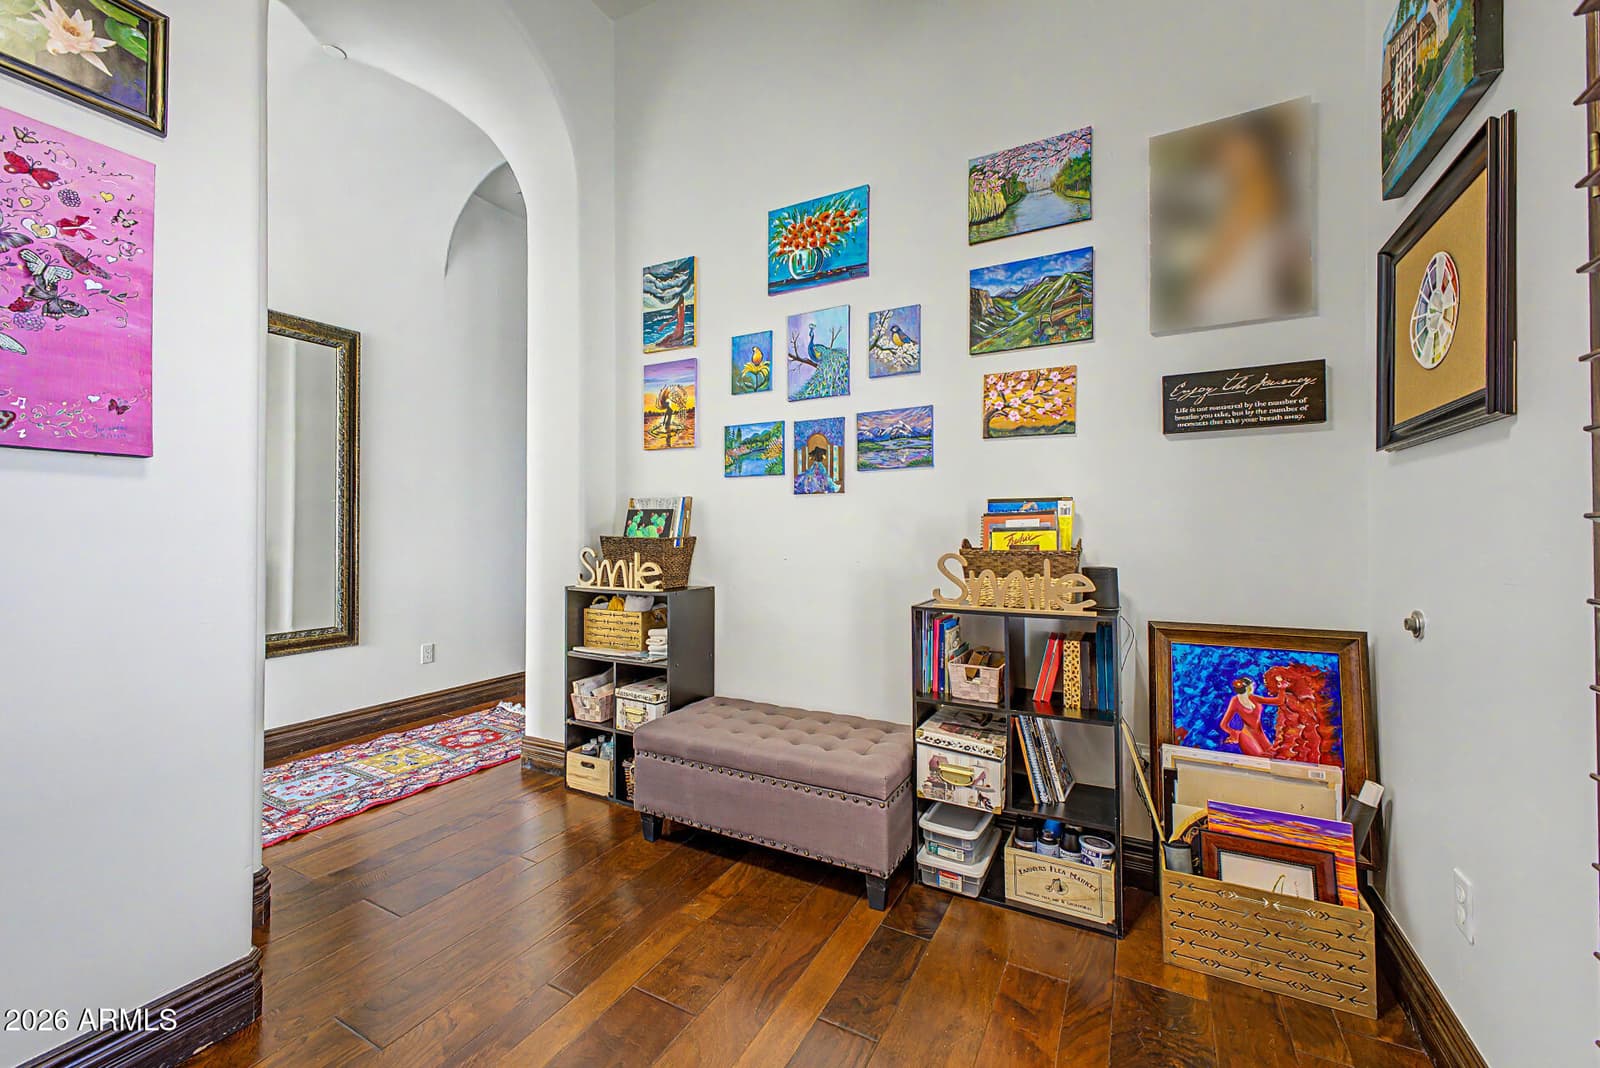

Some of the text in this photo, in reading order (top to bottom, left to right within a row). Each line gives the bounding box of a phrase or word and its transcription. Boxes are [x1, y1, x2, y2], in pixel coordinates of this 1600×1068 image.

[1170, 373, 1317, 405] Enjoy the journey
[1244, 401, 1254, 410] by
[1268, 398, 1297, 406] number
[1298, 396, 1309, 404] of
[1199, 413, 1213, 421] you
[1245, 409, 1255, 417] by
[1268, 405, 1298, 414] number
[1299, 404, 1310, 412] of
[577, 547, 663, 591] Smile
[932, 553, 1097, 614] Smile
[1049, 865, 1066, 875] FLEA
[1069, 872, 1098, 893] MARKET
